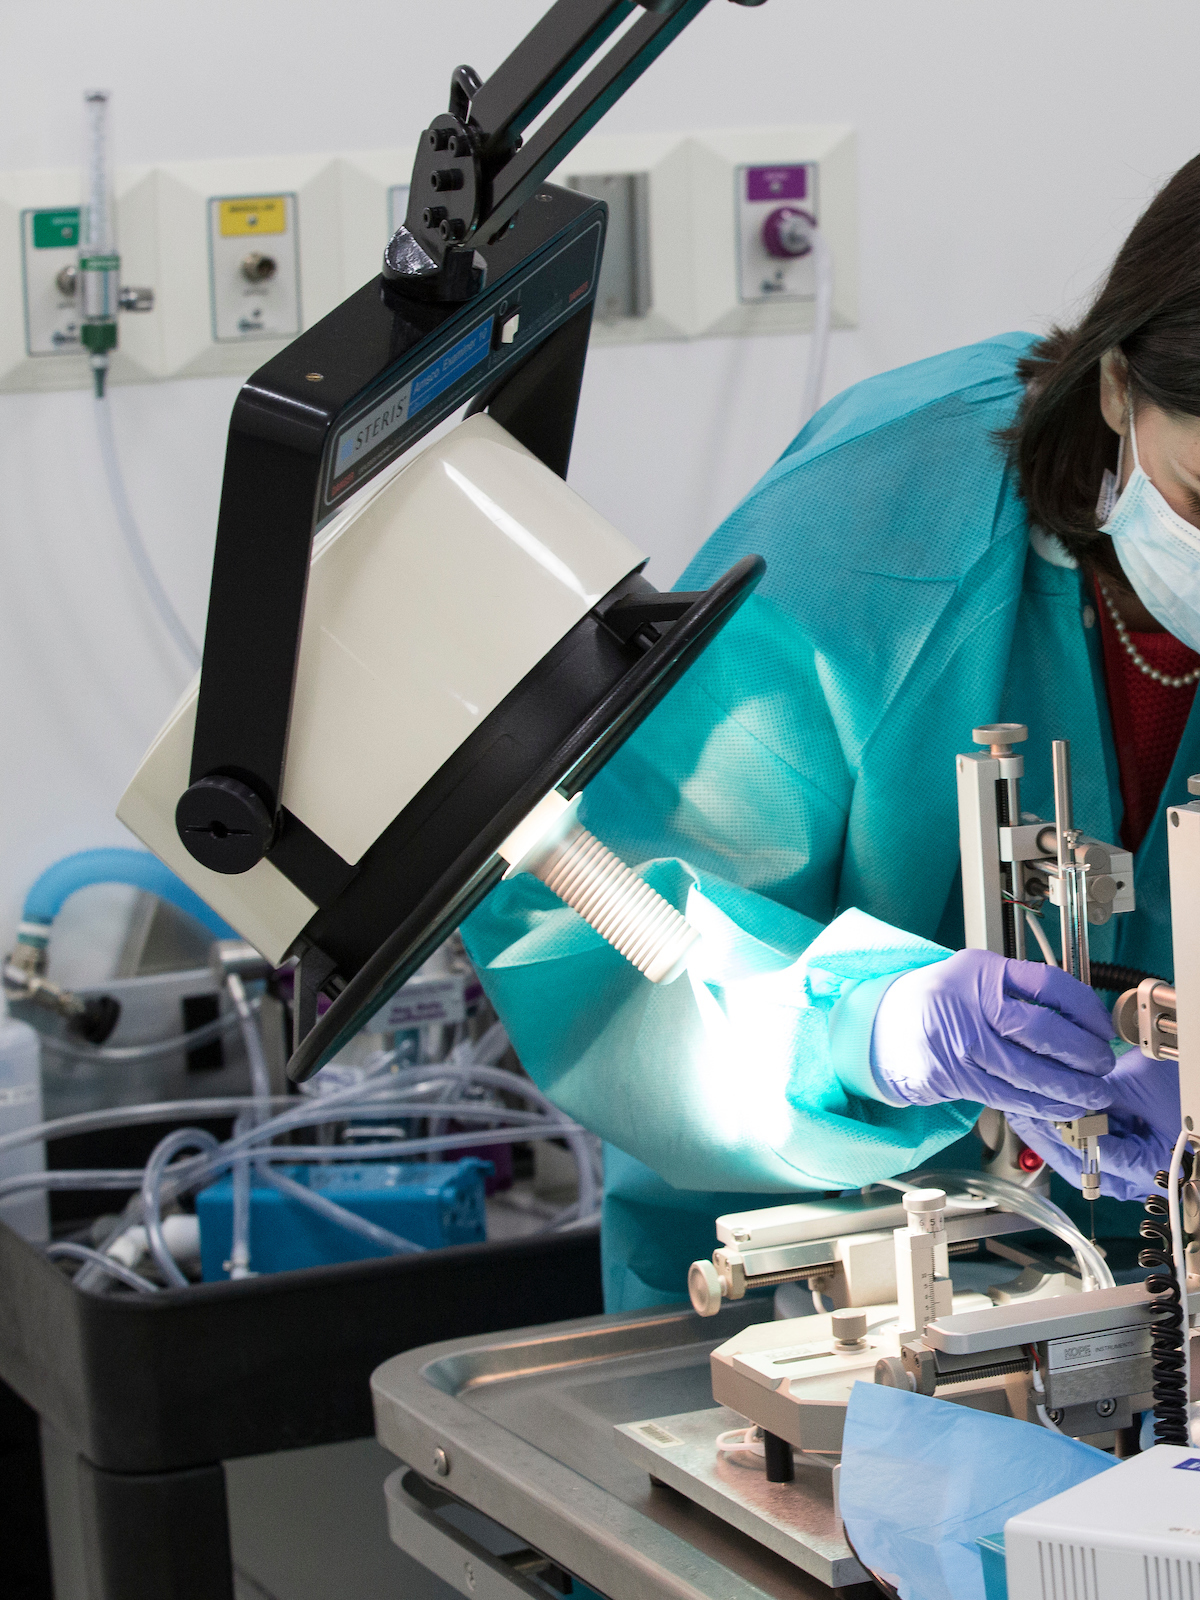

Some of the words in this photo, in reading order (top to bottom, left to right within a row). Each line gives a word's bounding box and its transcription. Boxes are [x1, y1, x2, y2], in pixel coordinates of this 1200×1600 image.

[355, 400, 406, 450] STERIS
[929, 1218, 936, 1226] 5
[1064, 1345, 1091, 1358] KOPF
